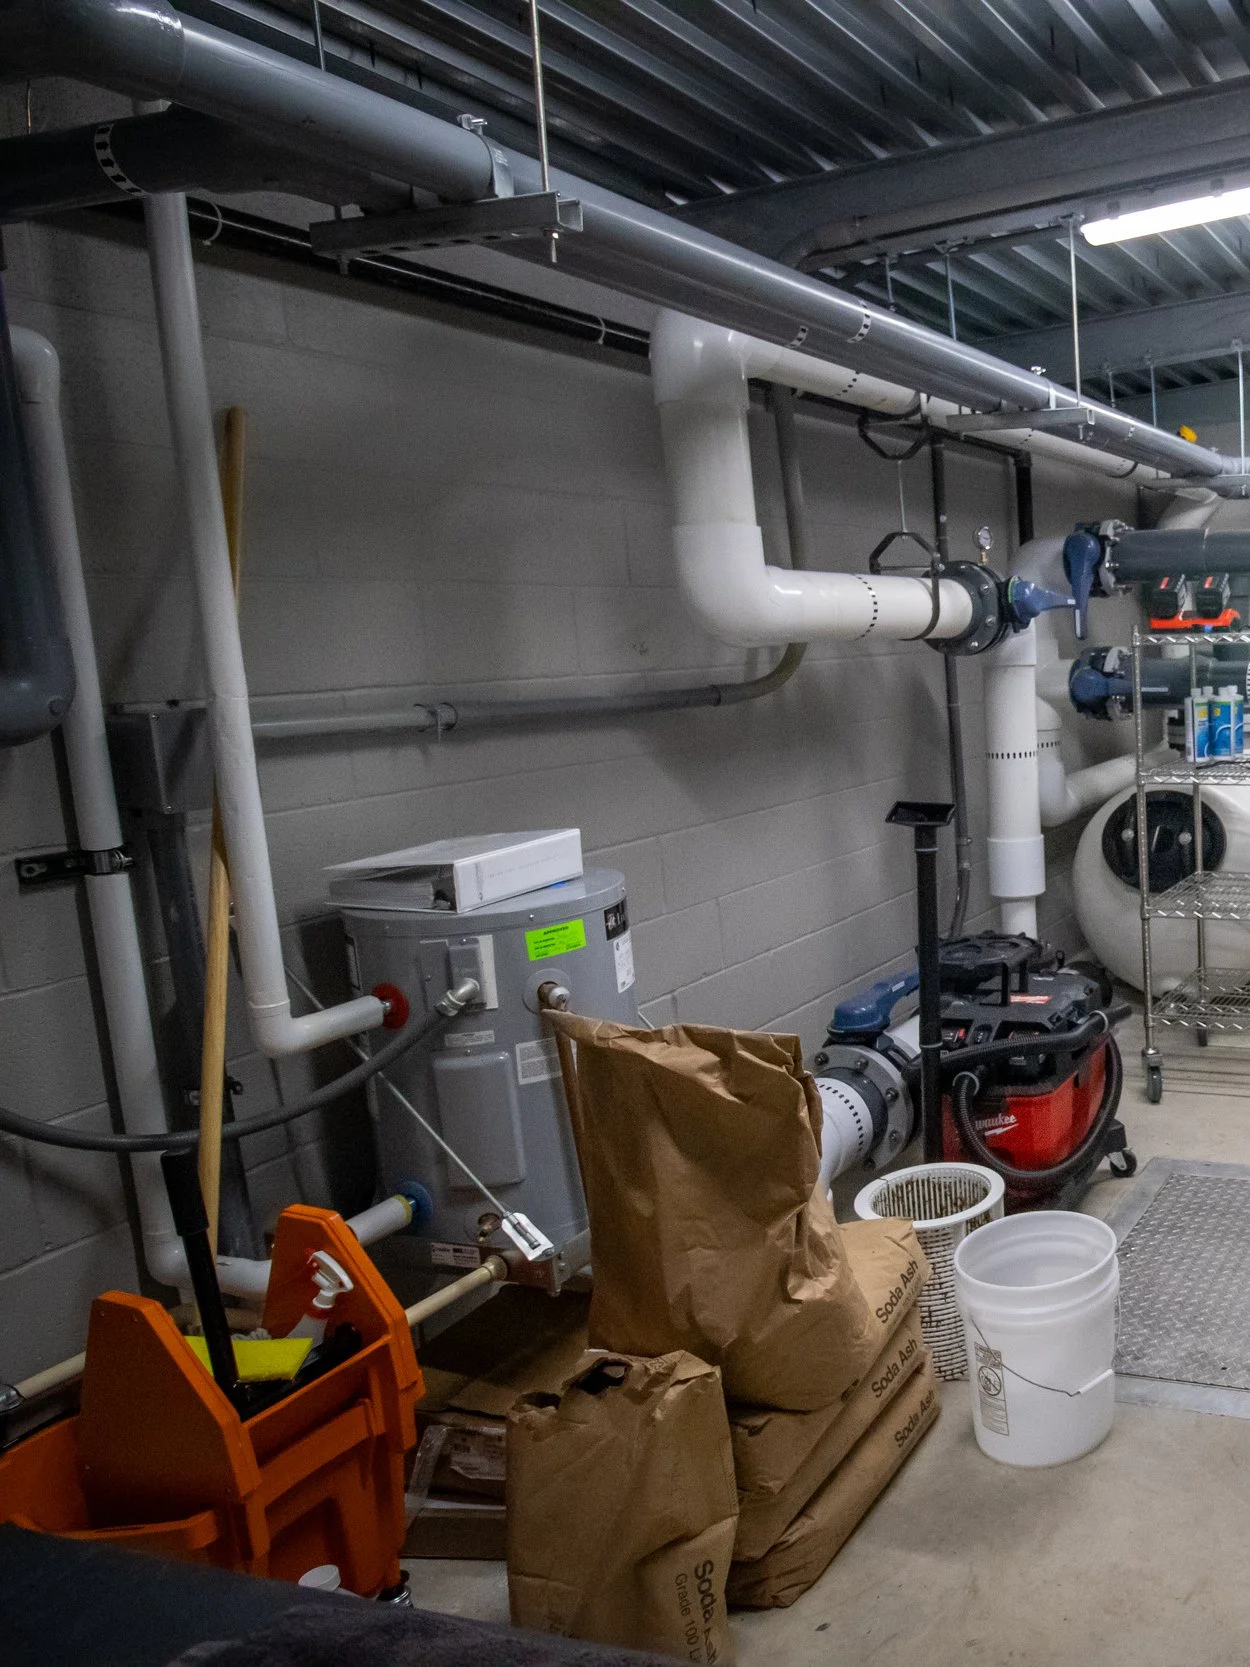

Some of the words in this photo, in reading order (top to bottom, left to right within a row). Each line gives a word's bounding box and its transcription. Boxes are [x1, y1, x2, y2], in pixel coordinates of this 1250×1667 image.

[974, 1113, 1016, 1130] waukee
[876, 1285, 903, 1324] Soda
[900, 1259, 919, 1290] Ash
[871, 1359, 900, 1398] Soda
[899, 1337, 918, 1368] Ash
[894, 1411, 920, 1449] Soda
[919, 1390, 935, 1422] Ash
[674, 1573, 692, 1617] Grade
[684, 1620, 700, 1646] 100
[694, 1559, 717, 1624] Soda
